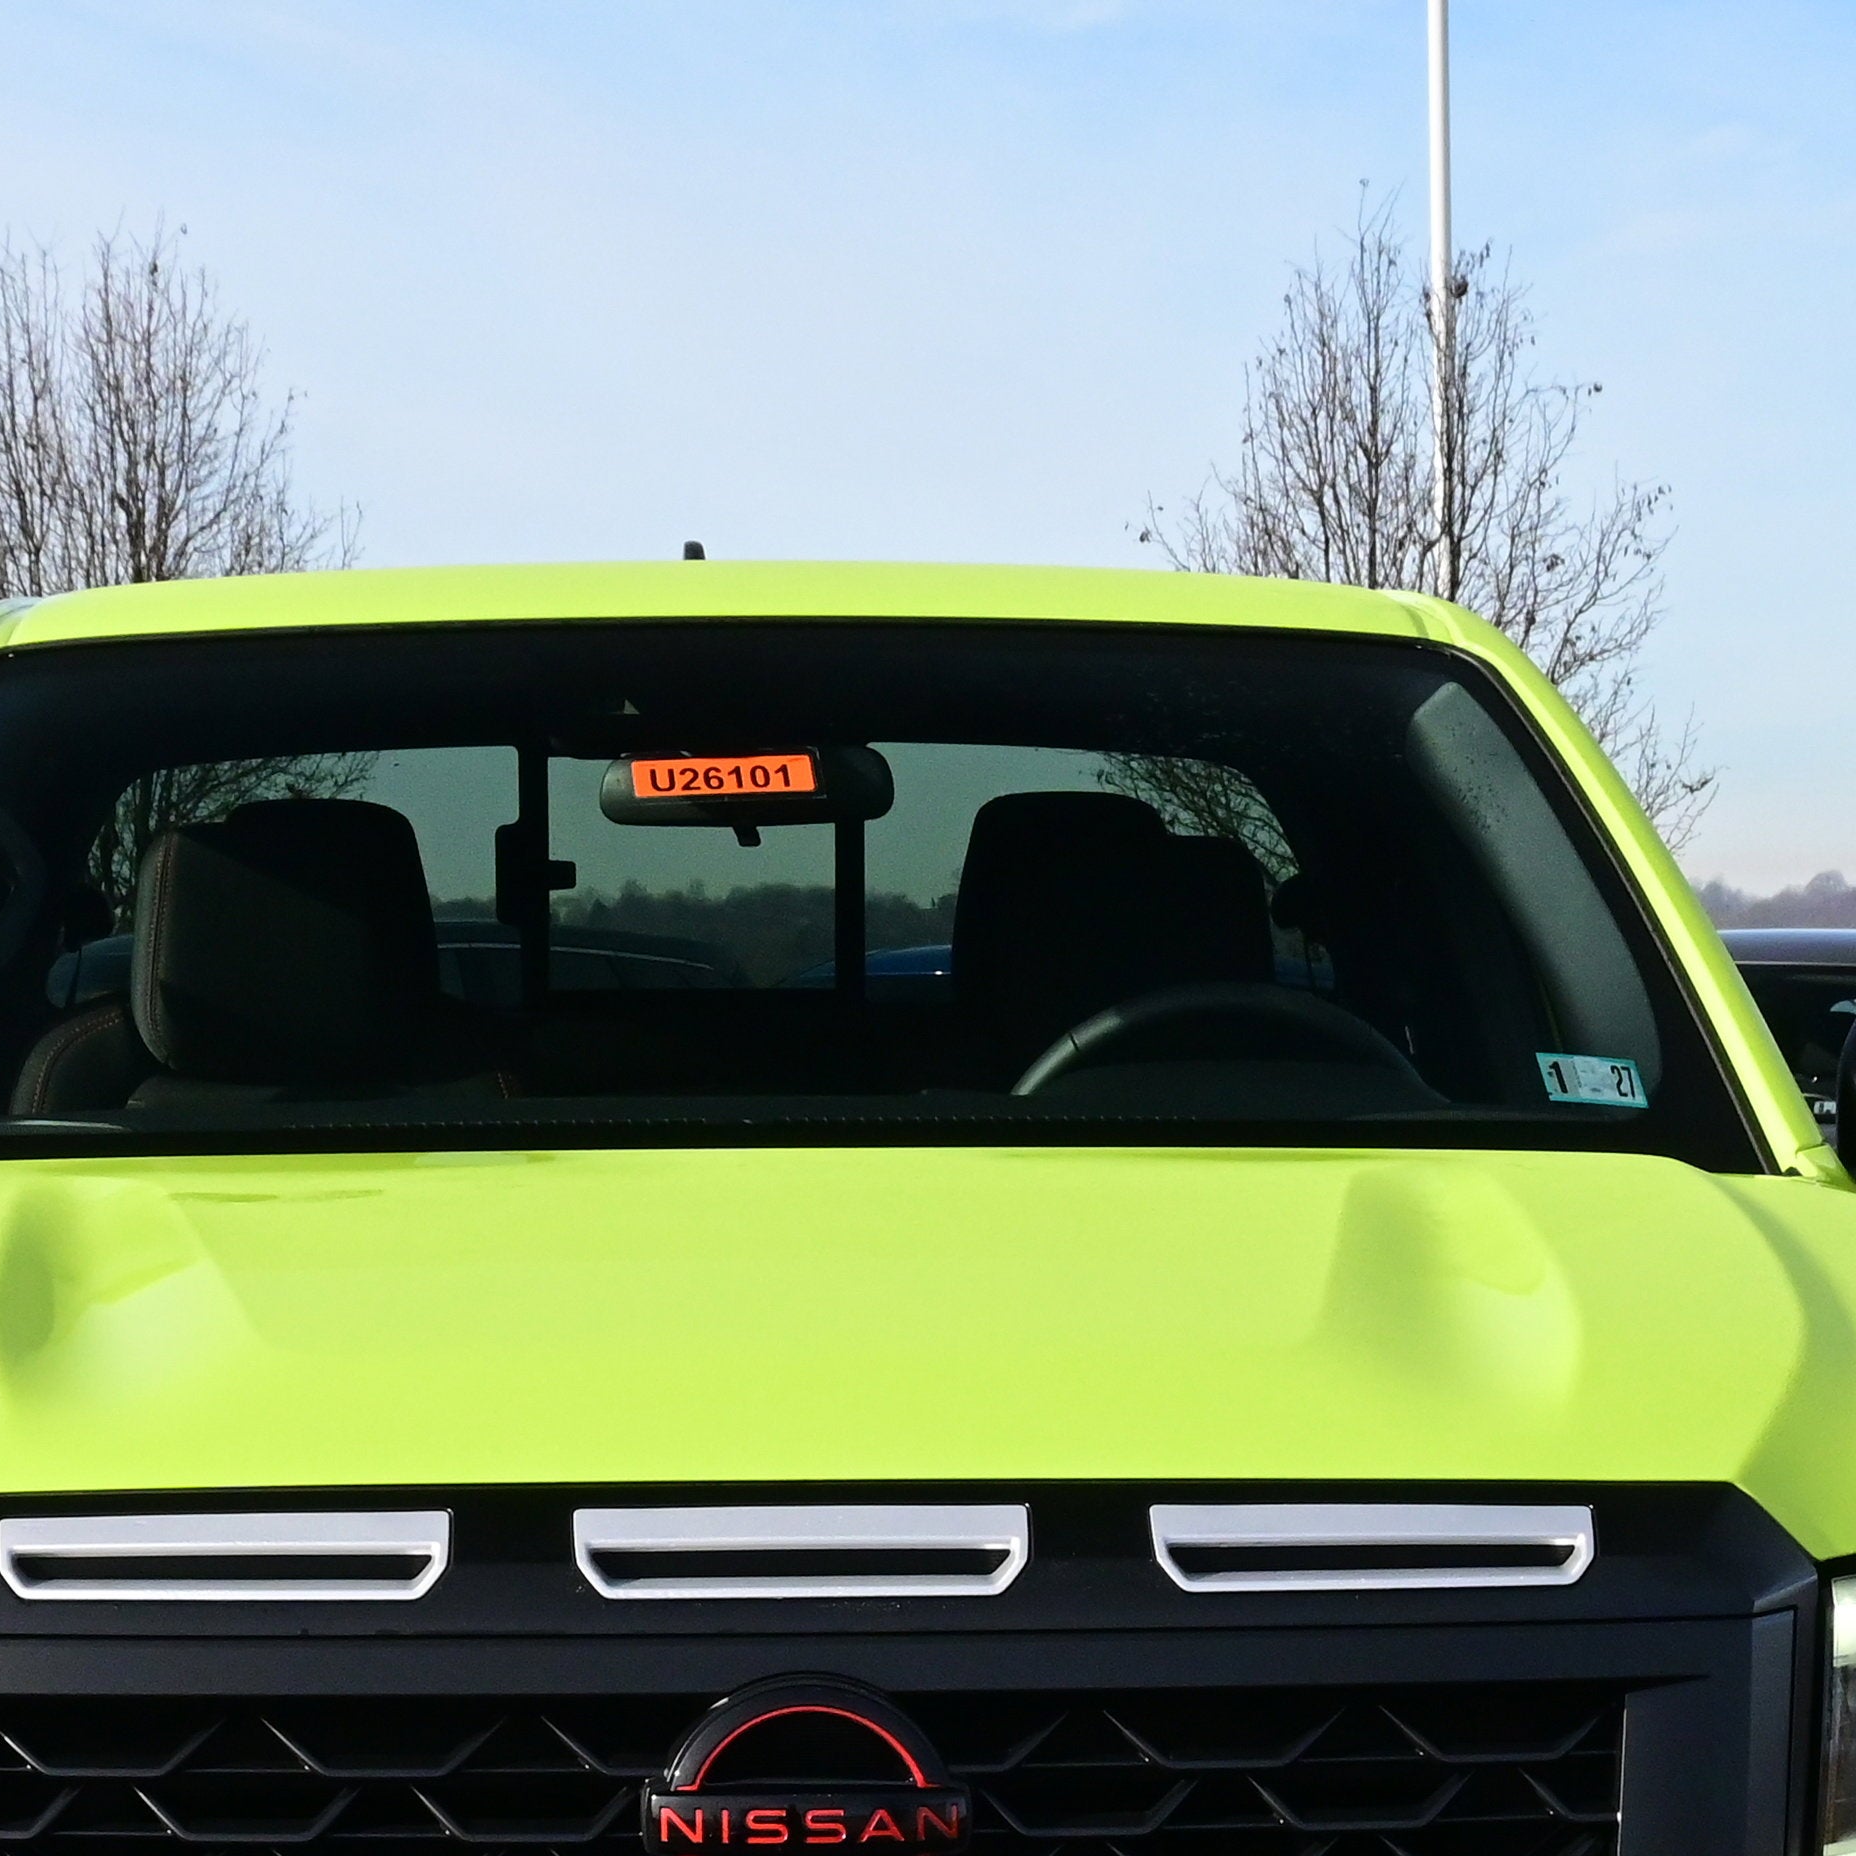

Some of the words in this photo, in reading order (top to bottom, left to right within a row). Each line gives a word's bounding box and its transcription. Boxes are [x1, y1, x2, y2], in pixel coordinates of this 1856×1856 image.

[648, 763, 792, 793] U26101
[1549, 1060, 1568, 1094] 1
[1610, 1065, 1636, 1099] 27
[659, 1805, 960, 1845] NISSAN
